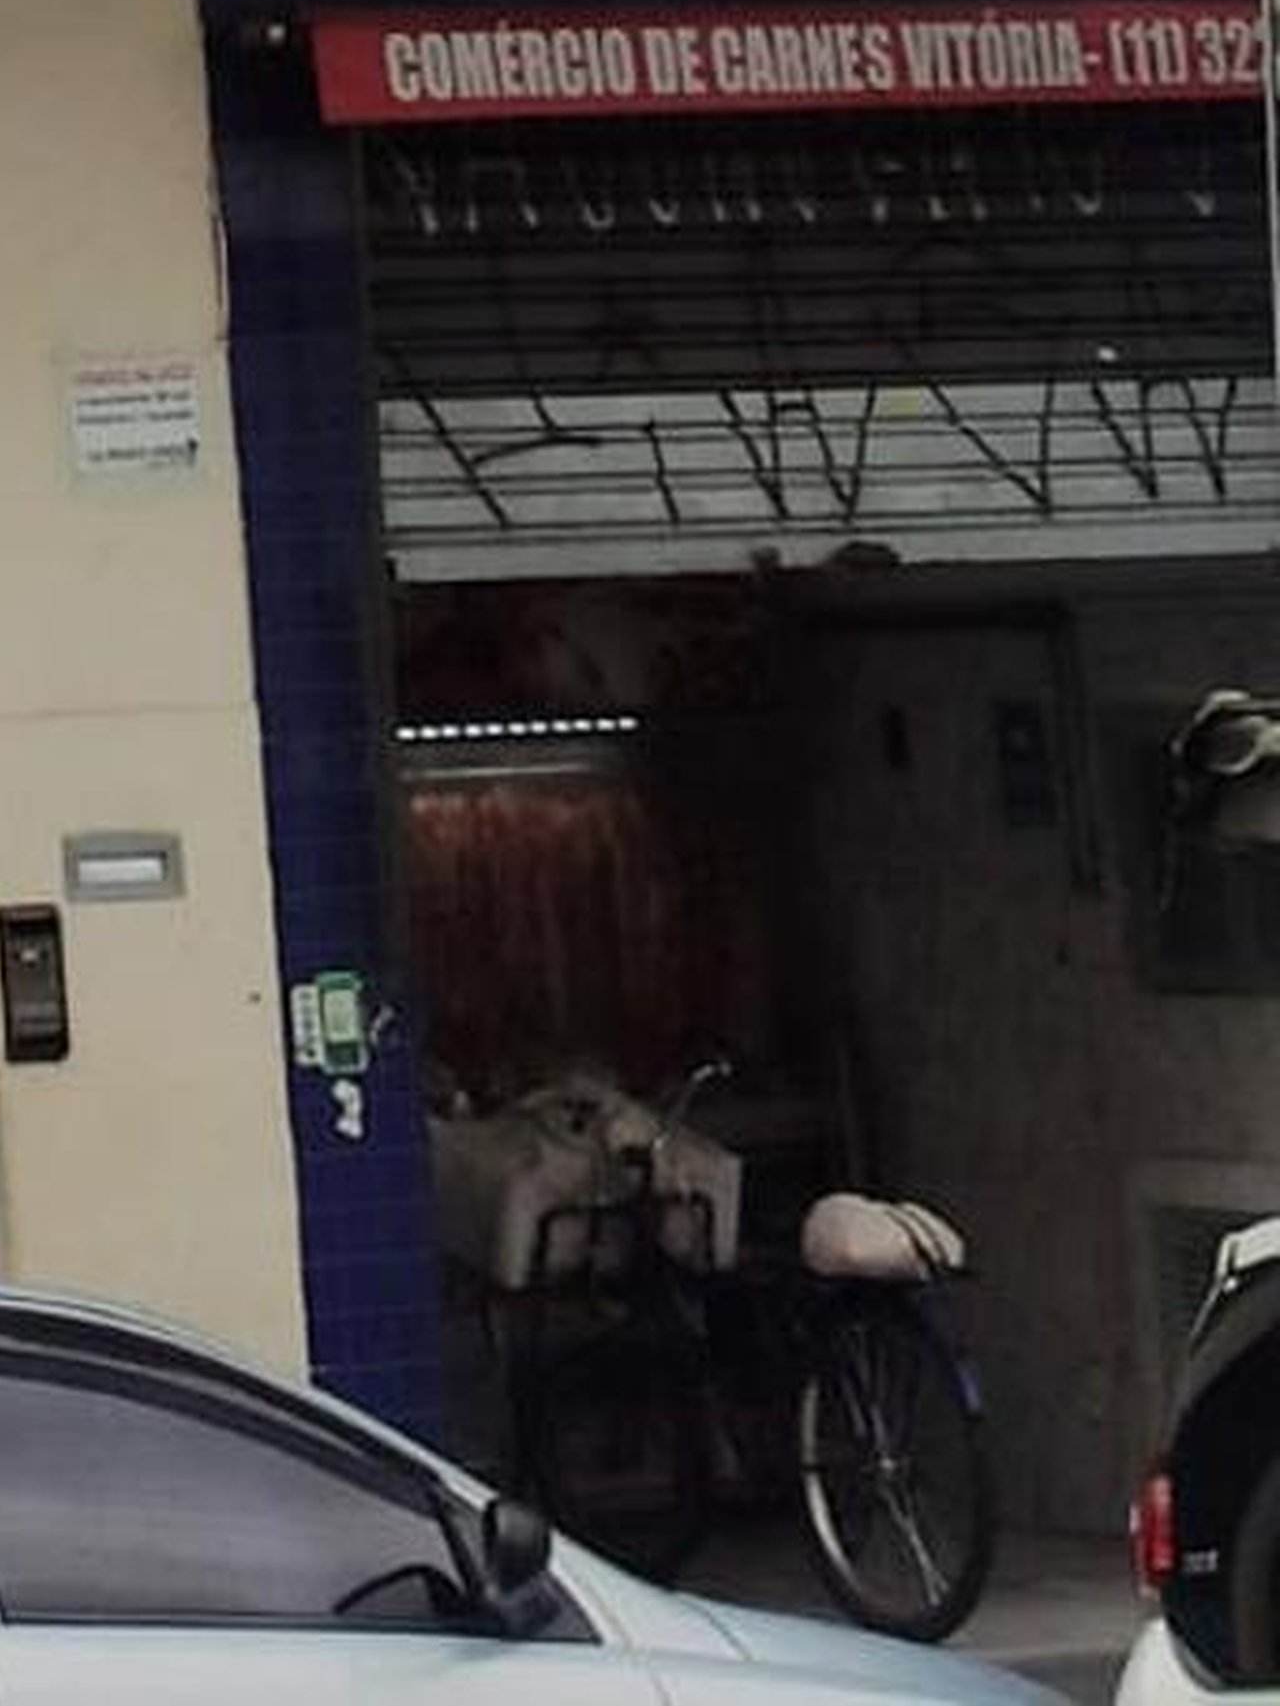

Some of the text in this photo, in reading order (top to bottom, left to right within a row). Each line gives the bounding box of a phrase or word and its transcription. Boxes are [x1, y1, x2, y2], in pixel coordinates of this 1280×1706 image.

[383, 21, 636, 102] COMÉRCIO
[641, 27, 707, 95] DE
[710, 19, 893, 94] CARNES
